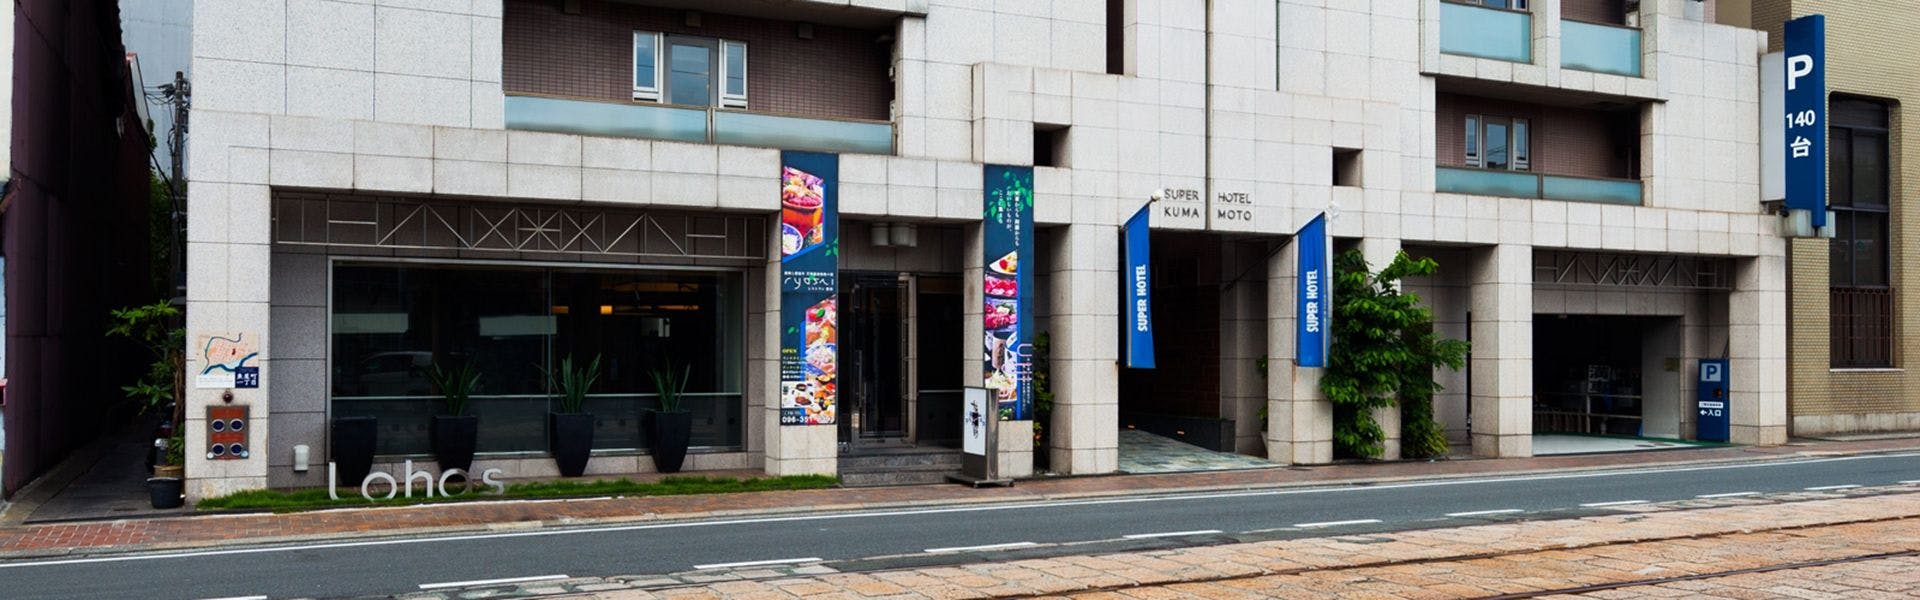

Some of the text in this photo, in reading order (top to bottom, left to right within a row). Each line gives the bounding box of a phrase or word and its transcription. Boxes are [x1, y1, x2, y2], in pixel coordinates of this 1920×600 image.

[1787, 54, 1814, 91] P
[1786, 109, 1816, 129] 140
[1790, 136, 1812, 158] 台
[1164, 188, 1252, 205] SUPER HOTEL
[1164, 206, 1252, 221] KUMA MOTO
[1136, 264, 1148, 332] SUPER HOTEL
[1306, 269, 1319, 333] SUPER HOTEL
[1706, 364, 1717, 380] P
[1707, 409, 1722, 417] 入口
